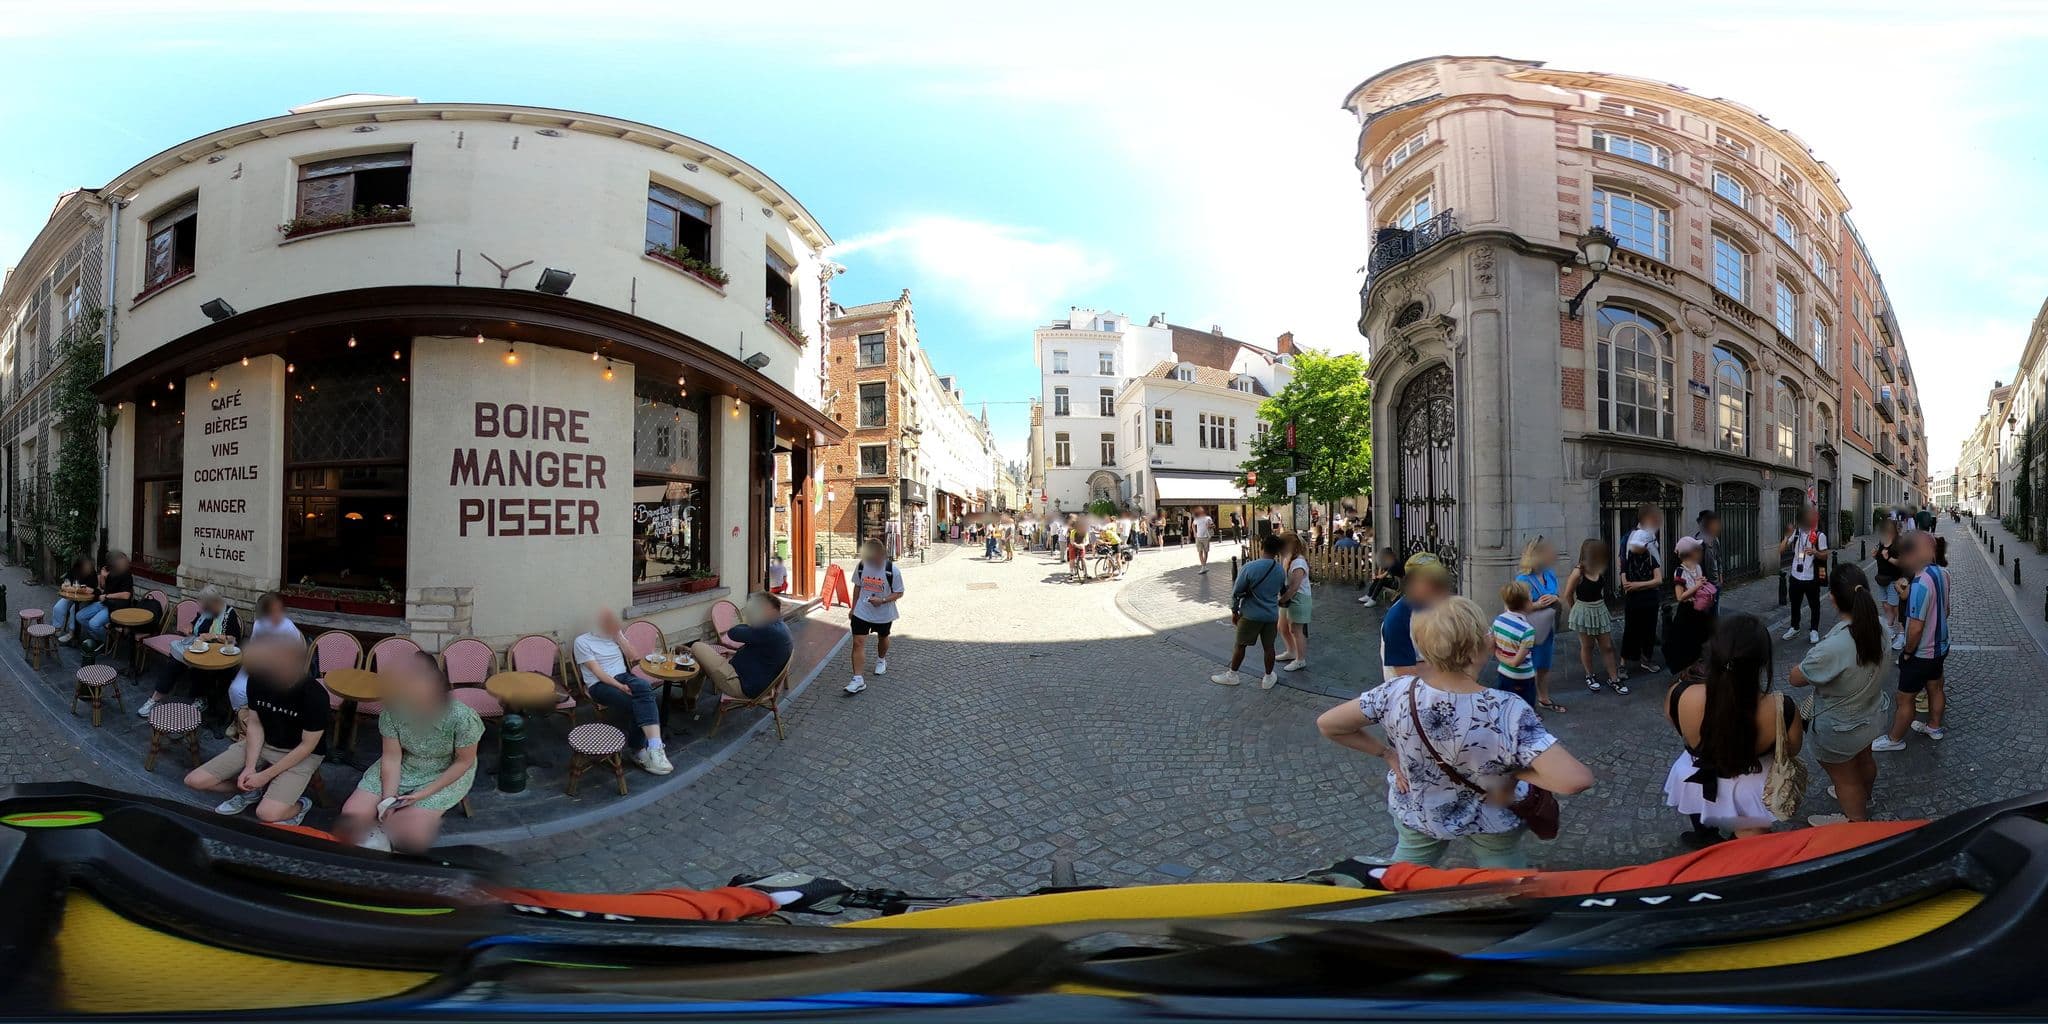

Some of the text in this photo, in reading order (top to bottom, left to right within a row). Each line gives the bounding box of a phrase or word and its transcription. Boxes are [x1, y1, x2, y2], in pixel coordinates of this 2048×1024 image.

[211, 389, 242, 411] CAFÉ
[204, 416, 248, 435] BIÈRES
[474, 402, 590, 444] BOIRE
[211, 441, 239, 457] VINS
[194, 465, 258, 483] COCKTAILS
[449, 448, 607, 490] MANGER
[198, 499, 246, 514] MANGER
[459, 498, 600, 537] PISSER
[194, 526, 255, 542] RESTAURANT
[199, 542, 246, 562] À L'ÉTAGE
